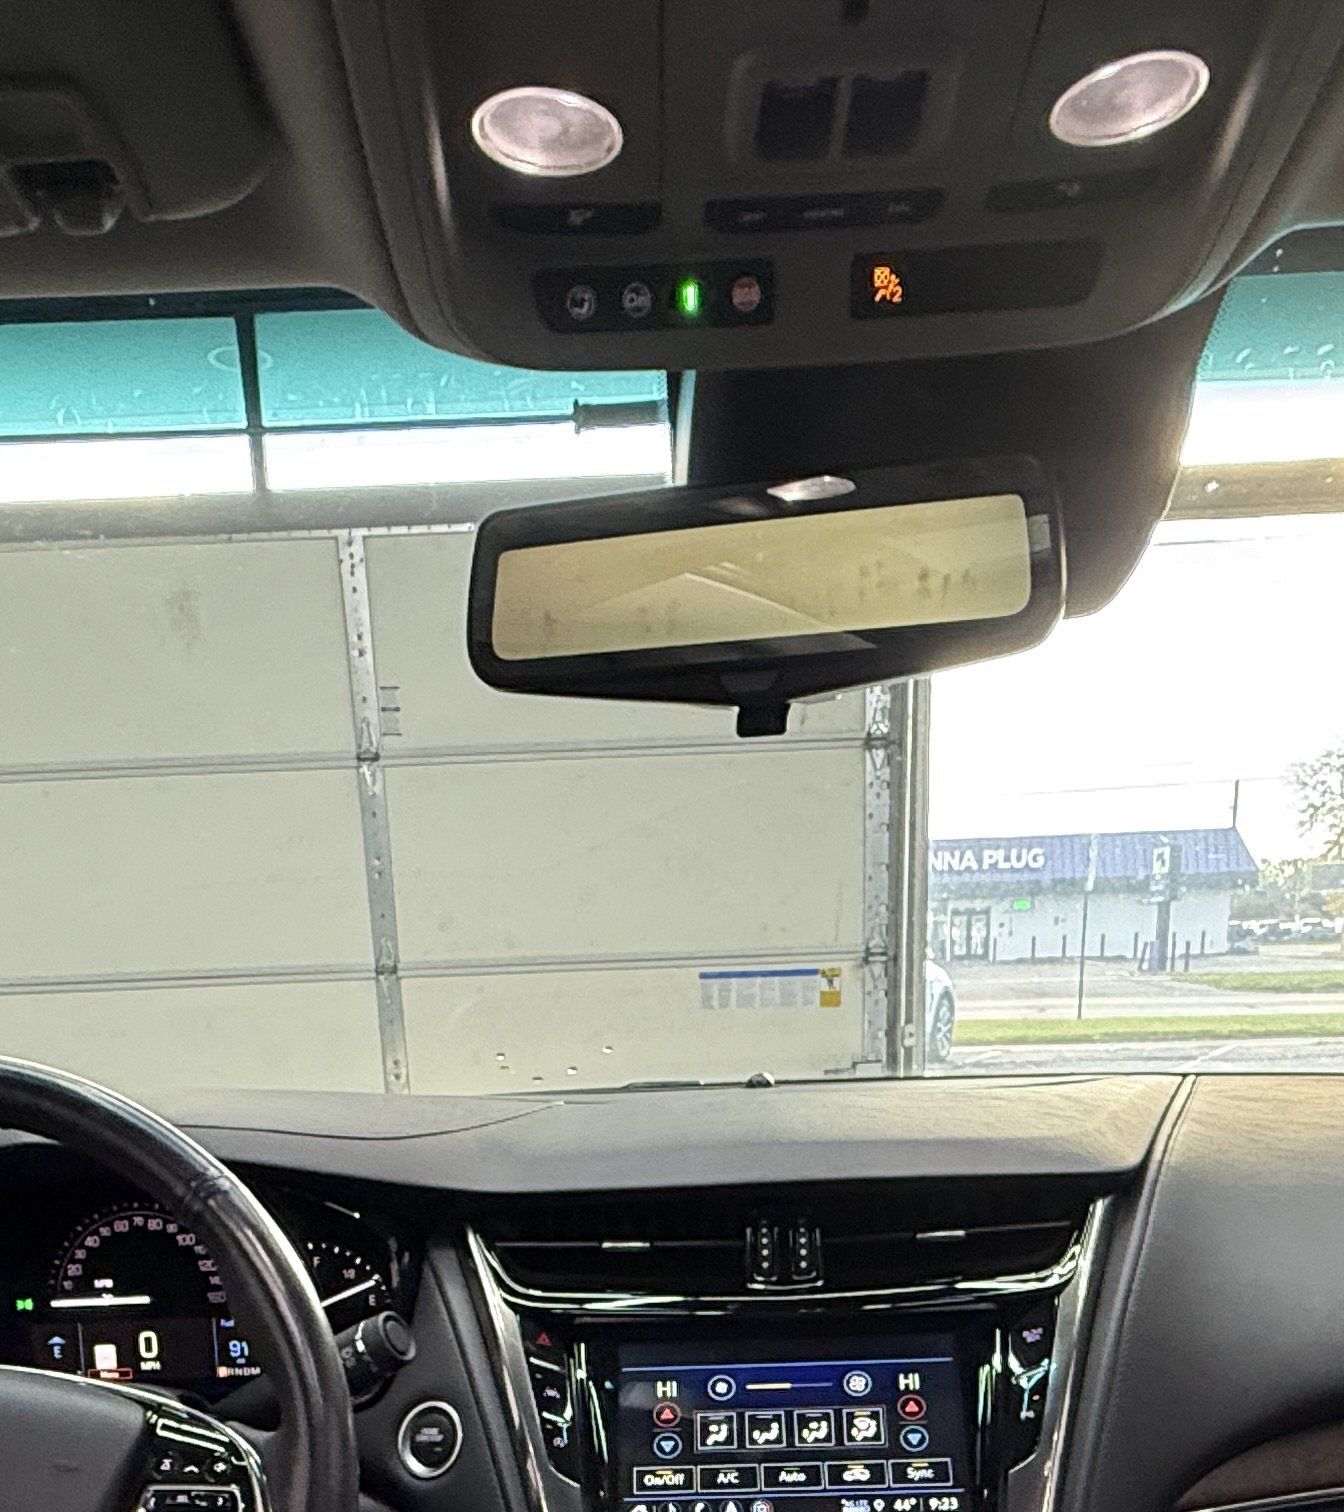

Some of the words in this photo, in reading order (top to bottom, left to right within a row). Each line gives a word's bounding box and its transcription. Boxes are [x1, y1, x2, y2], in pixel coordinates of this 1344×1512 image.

[982, 847, 1045, 870] PLUG
[147, 1218, 163, 1231] 80
[84, 1235, 100, 1248] 40
[176, 1233, 196, 1246] 100
[312, 1256, 321, 1268] F
[66, 1264, 83, 1277] 20
[368, 1294, 377, 1307] E
[138, 1330, 159, 1359] 0
[228, 1340, 249, 1358] 91
[898, 1373, 920, 1391] HI
[656, 1380, 678, 1398] HI
[643, 1473, 685, 1486] On/Off
[717, 1472, 740, 1484] A/C
[778, 1471, 807, 1483] Auto
[906, 1466, 934, 1480] Sync
